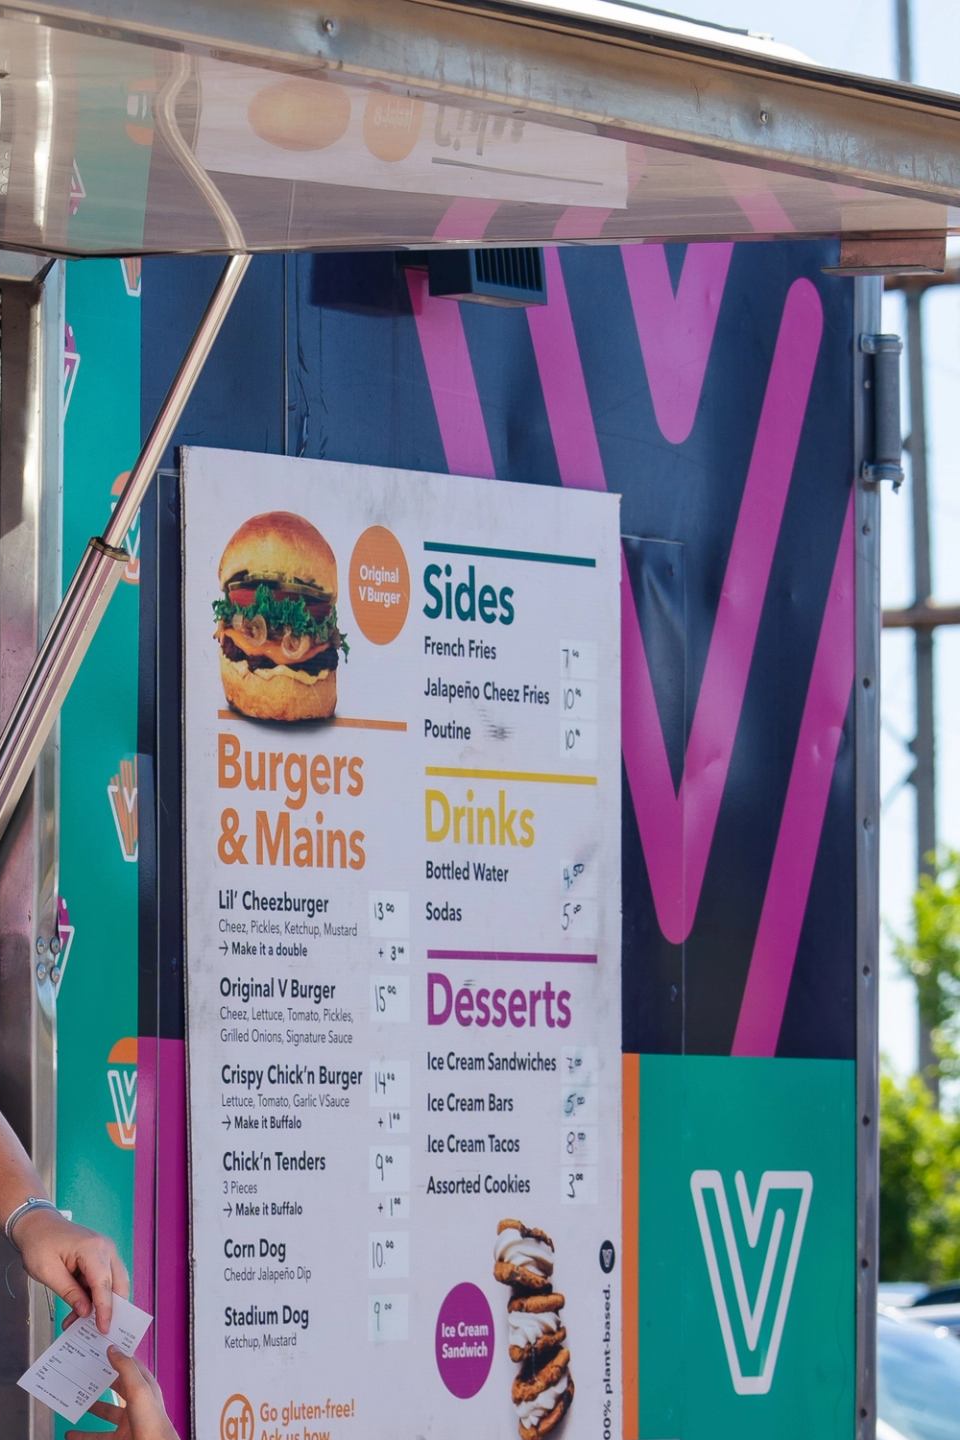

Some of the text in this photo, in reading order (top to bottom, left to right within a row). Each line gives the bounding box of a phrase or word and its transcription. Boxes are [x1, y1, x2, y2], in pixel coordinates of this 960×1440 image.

[360, 565, 399, 584] Original
[423, 563, 515, 625] Sides
[424, 636, 497, 660] French Fries
[424, 677, 550, 705] Jalapeño Cheez Fries
[424, 719, 471, 740] Poutine
[217, 733, 365, 810] Burgers
[425, 789, 535, 848] Drinks
[217, 808, 366, 871] & Mains
[426, 860, 509, 882] Bottled Water
[242, 891, 329, 917] Cheezburger
[426, 901, 462, 921] Sodas
[219, 919, 357, 939] Cheez, Pickles, Ketchup, Mustard
[232, 942, 308, 957] Make it a double
[220, 977, 336, 1004] Original V Burger
[427, 972, 571, 1029] Desserts
[220, 1007, 354, 1024] Cheez, Lettuce, Tomato, Pickles,
[220, 1029, 353, 1046] Grilled Onions, Signature Sauce
[427, 1052, 556, 1071] Ice Cream Sandwiches
[221, 1064, 263, 1090] Crispy
[319, 1066, 363, 1090] Burger
[221, 1094, 255, 1108] Lettuce,
[258, 1094, 291, 1109] Tomato,
[293, 1094, 317, 1107] Garlic
[427, 1093, 514, 1112] Ice Cream Bars
[234, 1115, 302, 1129] Make it Buffalo
[427, 1134, 520, 1153] Ice Cream Tacos
[275, 1151, 326, 1171] Tenders
[223, 1180, 257, 1194] 3 Pieces
[427, 1174, 530, 1194] Assorted Cookies
[235, 1201, 303, 1216] Make it Buffalo
[224, 1238, 286, 1262] Corn Dog
[224, 1266, 311, 1283] Cheddr Jalapeño Dip
[225, 1305, 309, 1329] Stadium Dog
[442, 1322, 488, 1337] Ice Cream
[603, 1284, 613, 1395] plant-based.
[225, 1333, 297, 1350] Ketchup, Mustard
[442, 1343, 488, 1359] Sandwich
[260, 1398, 355, 1426] Go gluten-free!
